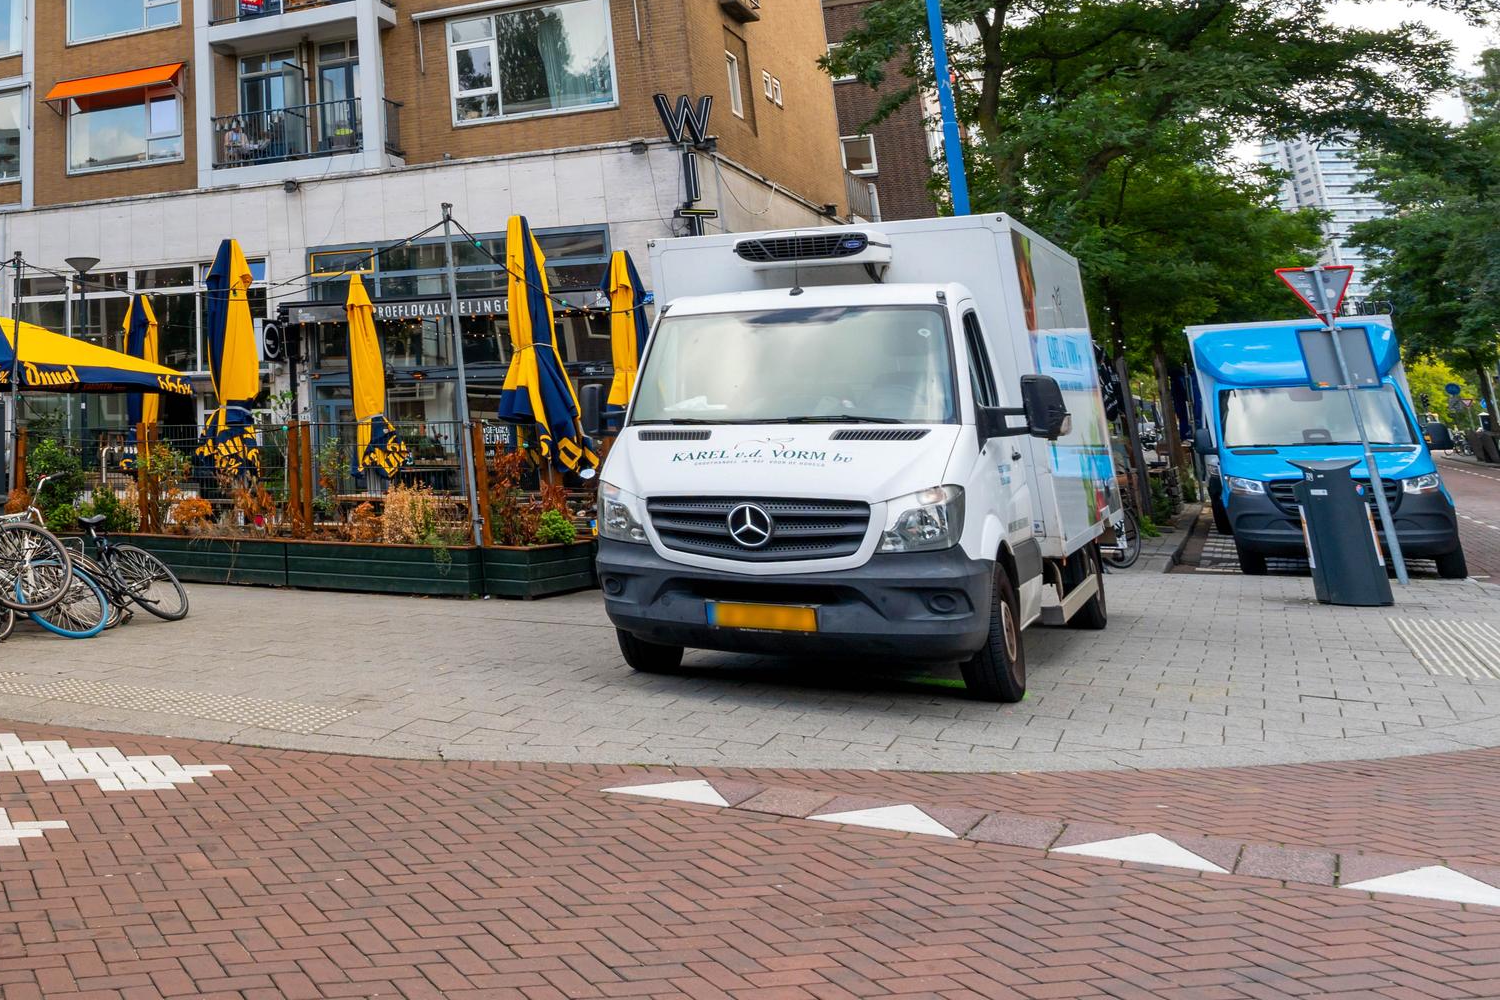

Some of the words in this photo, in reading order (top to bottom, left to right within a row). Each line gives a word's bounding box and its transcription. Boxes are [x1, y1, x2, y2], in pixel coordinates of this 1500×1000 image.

[378, 303, 447, 319] ROEFLOKAAL
[672, 450, 729, 462] KAREL
[772, 449, 826, 461] VORM
[833, 453, 853, 463] bv
